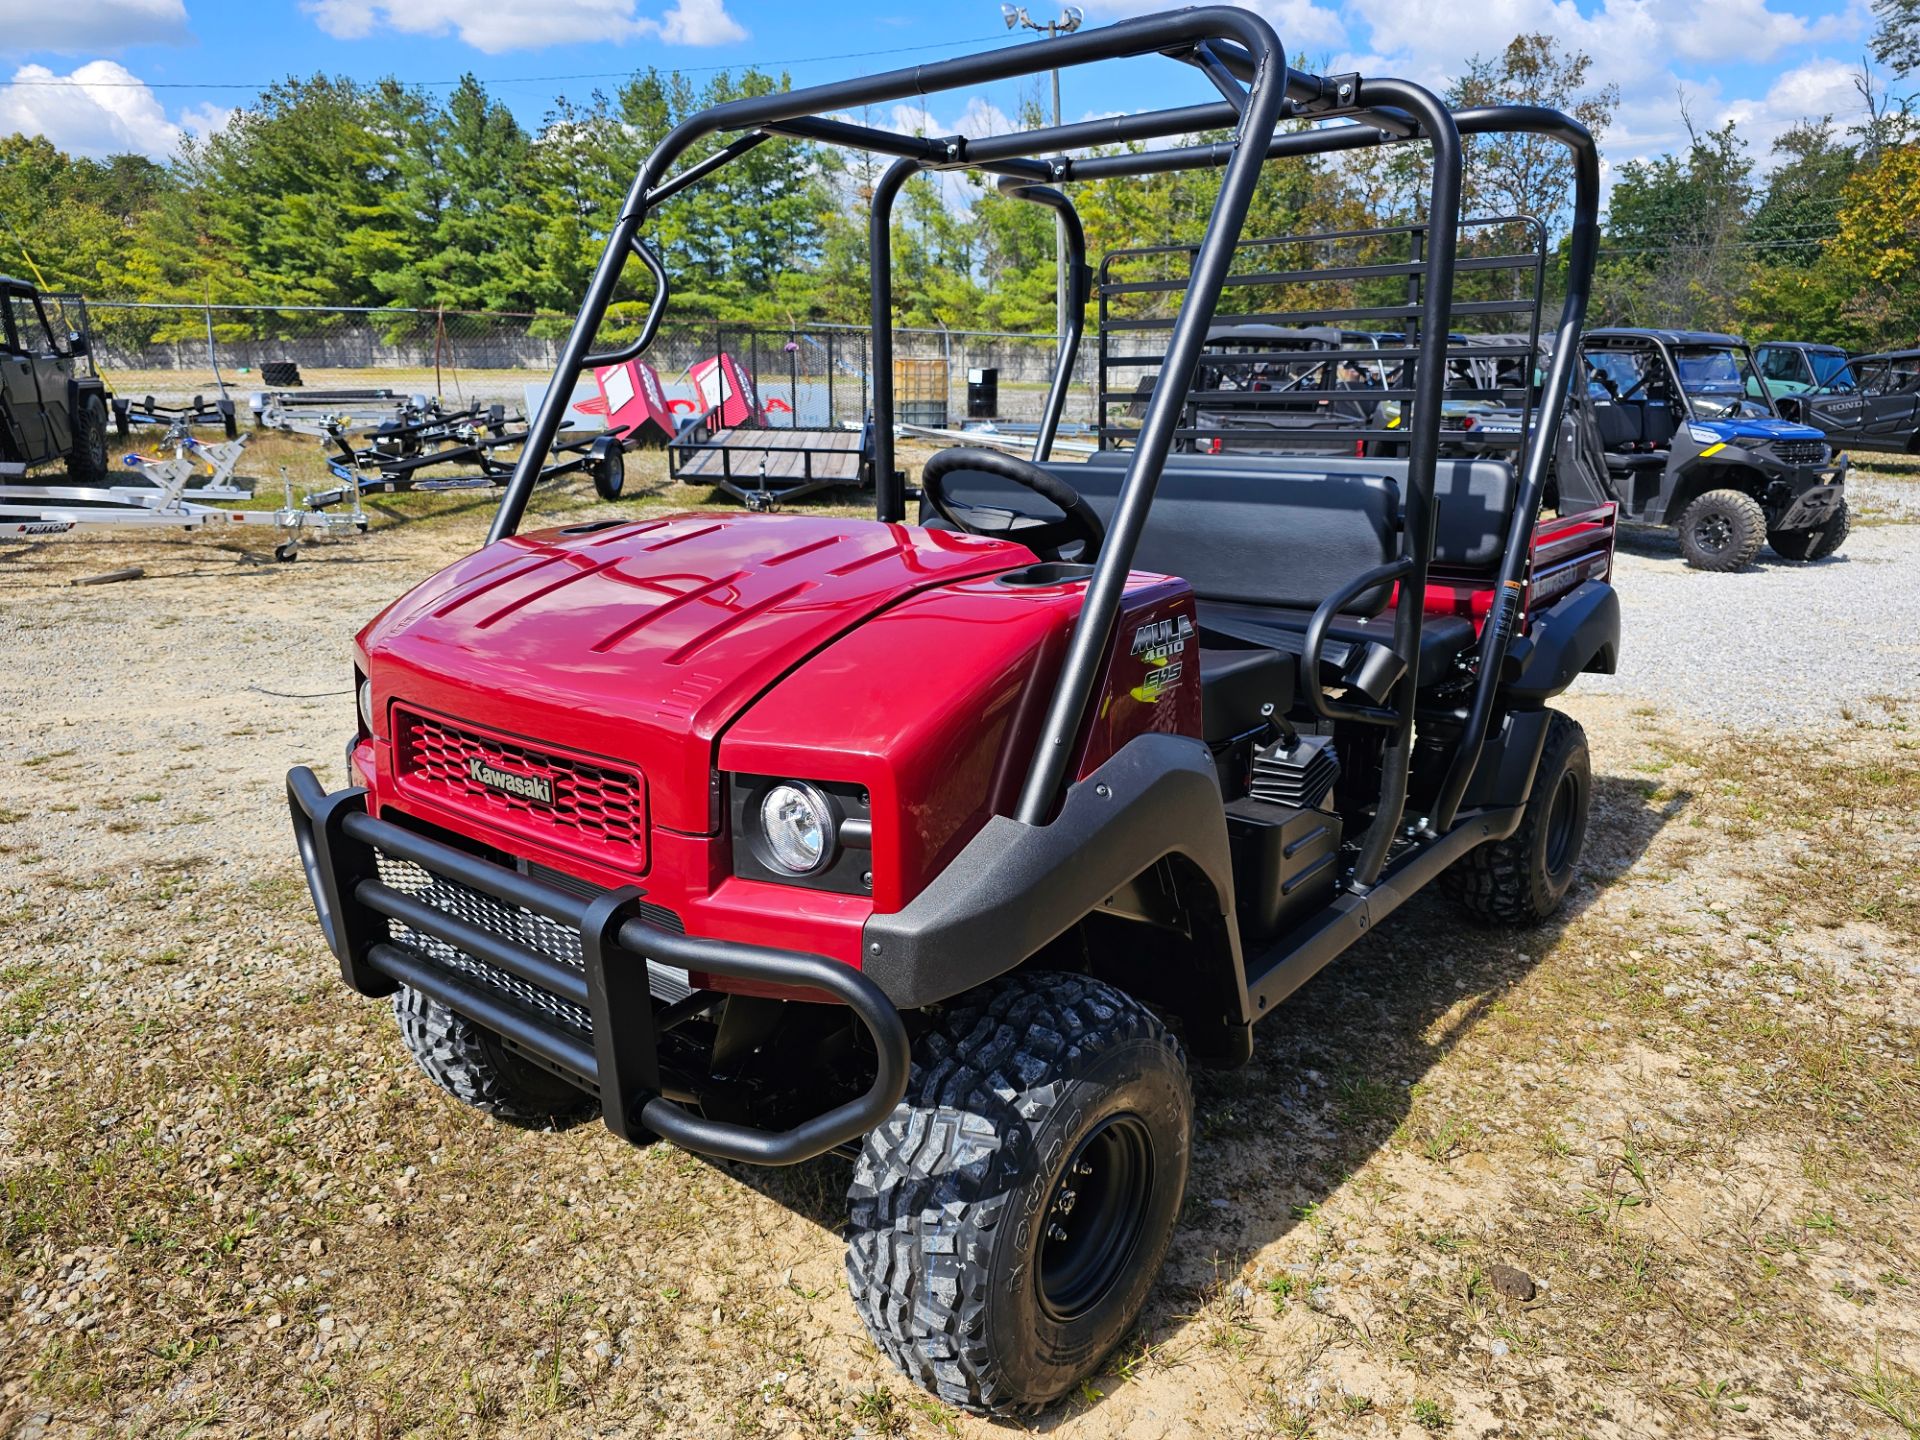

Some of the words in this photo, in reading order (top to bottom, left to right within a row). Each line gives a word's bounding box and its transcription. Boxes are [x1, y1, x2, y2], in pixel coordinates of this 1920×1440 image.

[1827, 400, 1872, 412] HONDA
[1130, 614, 1195, 655] MULE
[1144, 640, 1184, 661] 4010
[469, 759, 551, 803] Kawasaki
